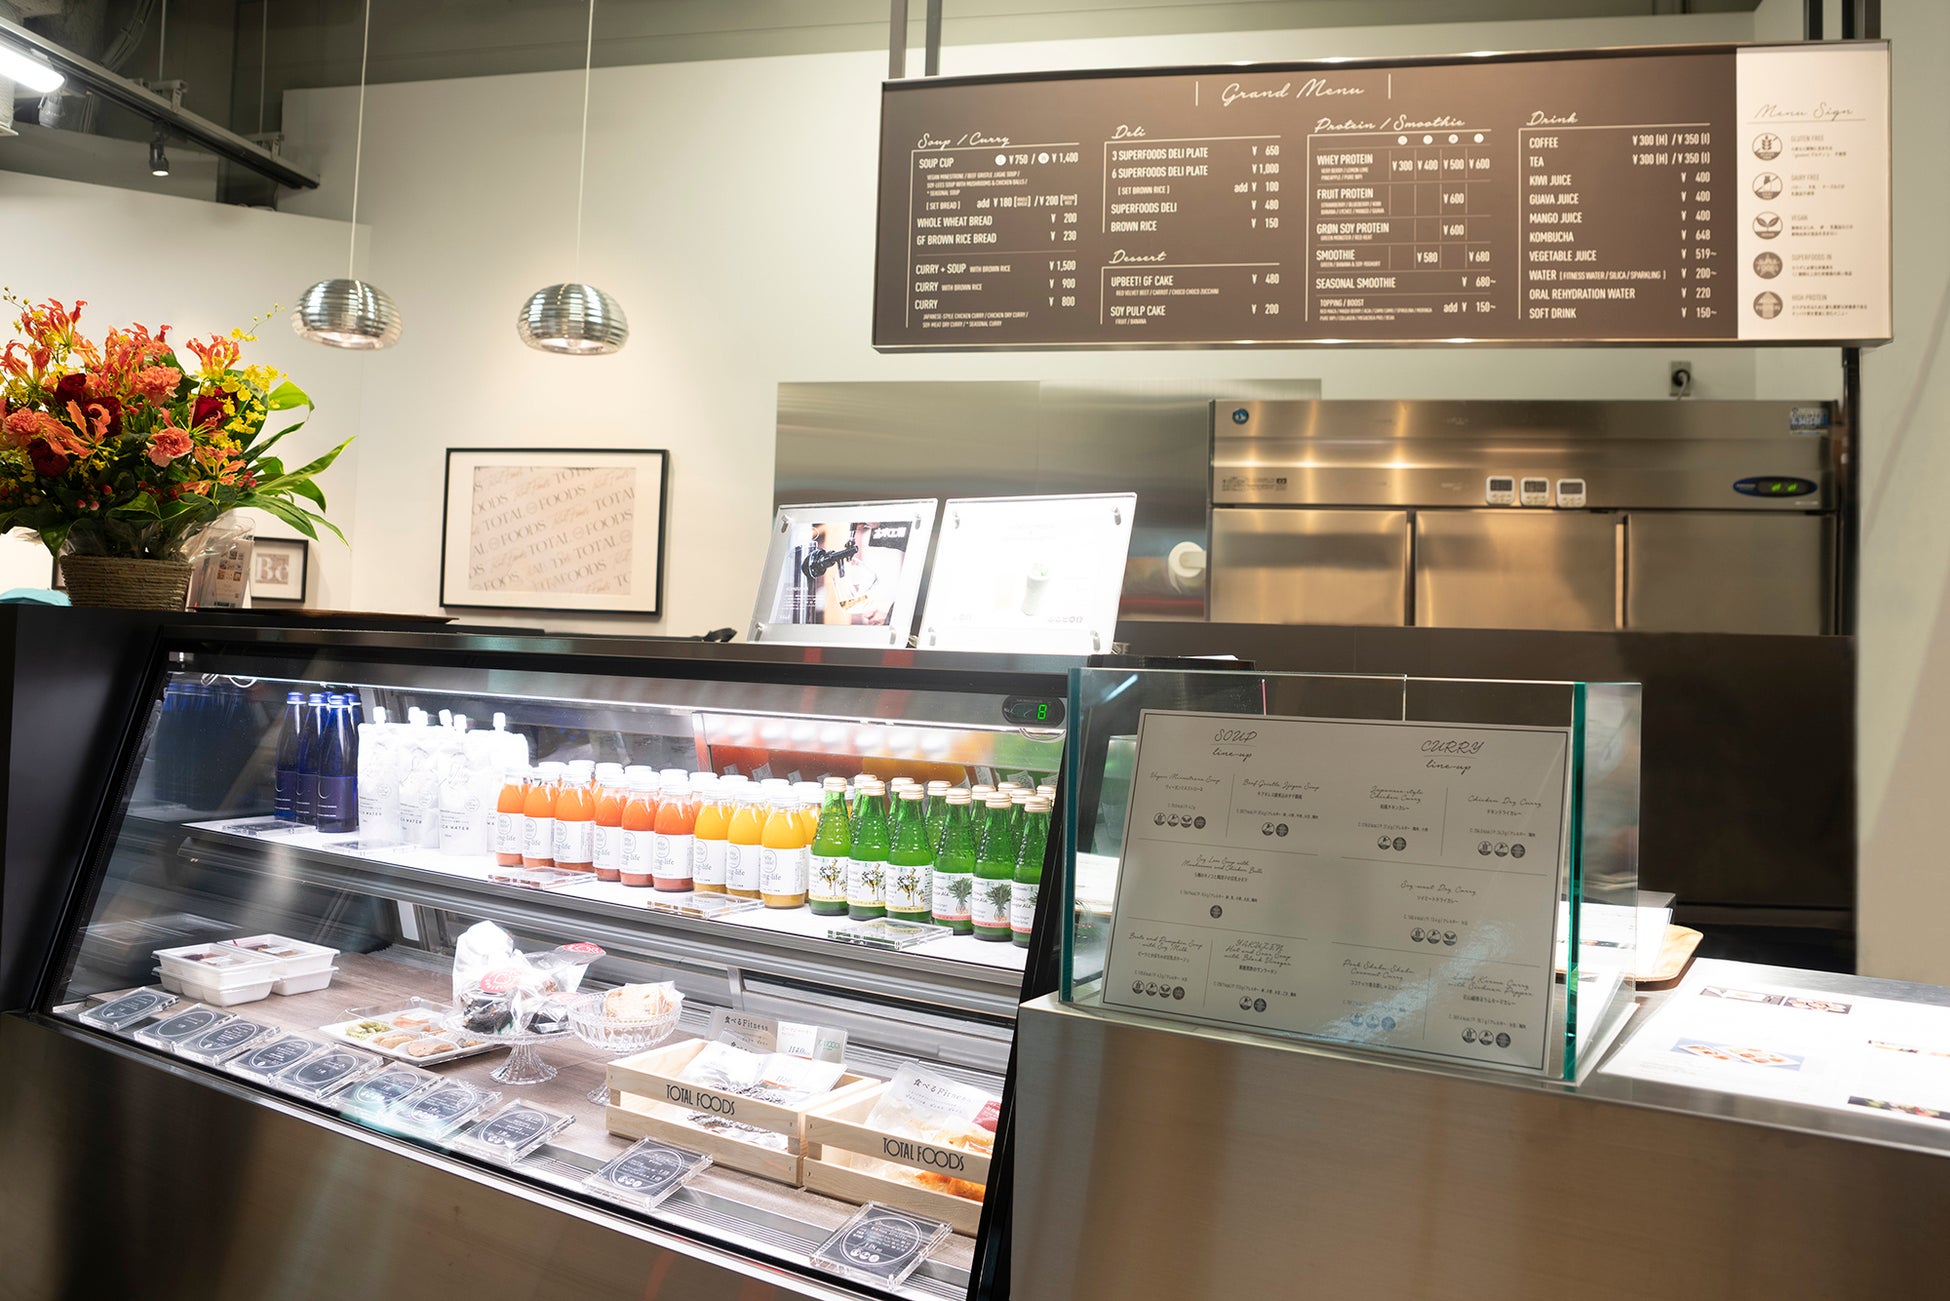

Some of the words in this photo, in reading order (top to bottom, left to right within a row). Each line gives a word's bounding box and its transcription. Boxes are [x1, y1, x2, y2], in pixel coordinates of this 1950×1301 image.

[1222, 83, 1290, 106] Grand
[1297, 78, 1365, 98] Menu
[1526, 110, 1578, 126] Drink
[1754, 104, 1807, 119] Menu
[1813, 102, 1854, 122] Sign
[1314, 117, 1376, 133] Protein
[1393, 114, 1465, 131] Smoothie
[1111, 125, 1146, 139] Deli
[918, 133, 951, 150] Soup
[970, 132, 1010, 148] Curry
[1529, 137, 1558, 149] COFFEE
[1639, 134, 1654, 145] 300
[1684, 133, 1699, 145] 350
[1112, 151, 1117, 161] 3
[1118, 149, 1167, 160] SUPERFOODS
[1168, 148, 1184, 159] DELI
[1186, 147, 1208, 158] PLATE
[1265, 145, 1279, 156] 650
[1317, 154, 1339, 166] WHEY
[1340, 154, 1373, 165] PROTEIN
[1529, 156, 1544, 167] TEA
[1639, 154, 1654, 165] 300
[1684, 153, 1699, 164] 350
[919, 158, 938, 168] SOUP
[939, 158, 954, 168] CUP
[1015, 154, 1028, 164] 750
[1112, 169, 1117, 179] 6
[1118, 167, 1166, 178] SUPERFOODS
[1168, 166, 1184, 177] DELI
[1186, 165, 1208, 176] PLATE
[1529, 175, 1548, 186] KIWI
[1550, 175, 1572, 186] JUICE
[1695, 171, 1711, 183] 400
[1122, 186, 1132, 195] SET
[1132, 186, 1152, 194] BROWN
[1153, 186, 1166, 194] RICE
[1234, 182, 1248, 193] add
[1317, 189, 1338, 200] FRUIT
[1340, 188, 1373, 199] PROTEIN
[929, 202, 939, 210] SET
[977, 199, 990, 208] add
[1046, 196, 1058, 206] 200
[1529, 194, 1555, 205] GUAVA
[1557, 193, 1579, 205] JUICE
[1695, 191, 1711, 202] 400
[1111, 203, 1159, 214] SUPERFOODS
[1161, 203, 1177, 213] DELI
[917, 217, 941, 228] WHOLE
[943, 216, 967, 227] WHEAT
[969, 215, 992, 226] BREAD
[1064, 213, 1077, 223] 200
[1529, 213, 1558, 224] MANGO
[1560, 212, 1582, 223] JUICE
[1695, 210, 1711, 221] 400
[1111, 221, 1138, 232] BROWN
[1140, 221, 1157, 231] RICE
[1265, 218, 1278, 228] 150
[1340, 223, 1355, 234] SOY
[1356, 222, 1389, 233] PROTEIN
[916, 235, 926, 246] GF
[928, 234, 954, 245] BROWN
[955, 234, 972, 244] RICE
[973, 233, 997, 243] BREAD
[1063, 231, 1077, 240] 230
[1529, 232, 1574, 243] KOMBUCHA
[1695, 229, 1711, 241] 648
[1109, 249, 1167, 264] Dessert
[1316, 250, 1355, 261] SMOOTHIE
[1529, 251, 1573, 262] VEGETABLE
[1574, 250, 1597, 262] JUICE
[916, 264, 939, 275] CURRY
[947, 263, 967, 274] SOUP
[1057, 260, 1076, 271] 1,500
[1111, 276, 1142, 287] UPBEET!
[1143, 276, 1152, 286] GF
[1154, 275, 1173, 286] CAKE
[1529, 270, 1557, 281] WATER
[1563, 271, 1585, 280] FITNESS
[1586, 271, 1605, 280] WATER
[1630, 271, 1661, 279] SPARKLING
[915, 282, 938, 292] CURRY
[1062, 278, 1076, 288] 900
[1316, 278, 1355, 289] SEASONAL
[1356, 277, 1396, 288] SMOOTHIE
[1529, 289, 1550, 300] ORAL
[1552, 288, 1605, 300] REHYDRATION
[1607, 288, 1636, 299] WATER
[1696, 287, 1711, 298] 220
[915, 300, 938, 310] CURRY
[1110, 306, 1125, 317] SOY
[1126, 306, 1145, 316] PULP
[1147, 305, 1166, 316] CAKE
[1264, 304, 1279, 314] 200
[1320, 299, 1343, 307] TOPPING
[1347, 299, 1364, 307] BOOST
[1443, 303, 1458, 313] add
[1529, 308, 1549, 319] SOFT
[1551, 308, 1576, 319] DRINK
[1038, 704, 1047, 719] 8
[1214, 728, 1258, 742] SOUP
[1421, 740, 1486, 755] CURRY
[1212, 748, 1252, 762] line-up
[1426, 760, 1471, 775] line-up
[666, 1083, 693, 1108] TOTAL
[695, 1092, 736, 1116] FOODS
[882, 1137, 914, 1161] TOTAL
[916, 1146, 964, 1171] FOODS
